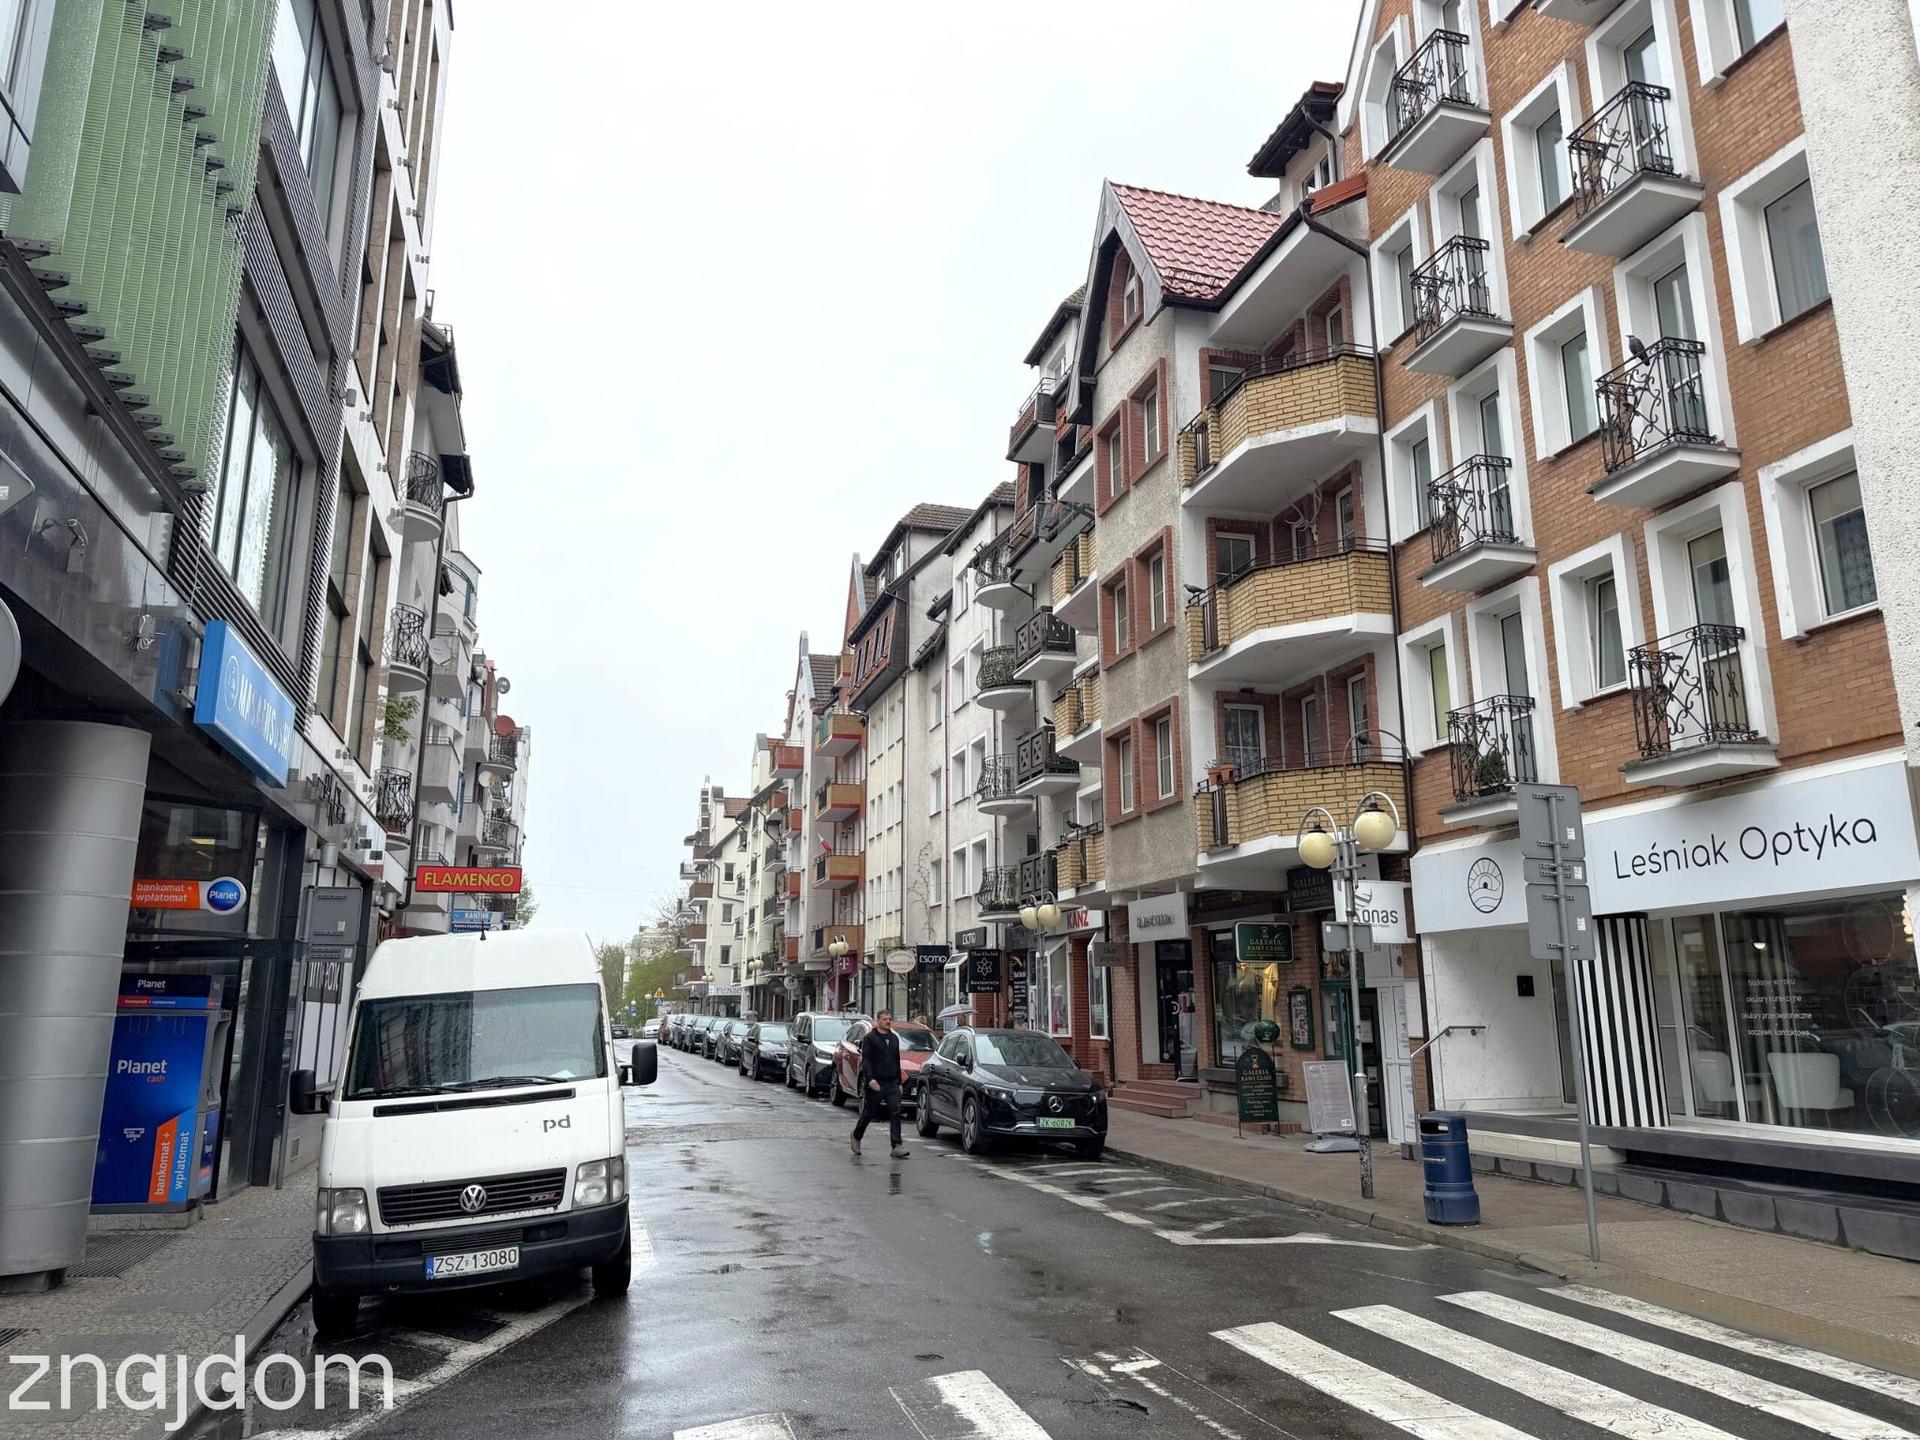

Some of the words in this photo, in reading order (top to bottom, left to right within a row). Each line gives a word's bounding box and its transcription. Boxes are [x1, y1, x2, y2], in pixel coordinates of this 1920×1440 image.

[1614, 833, 1728, 879] Leśniak
[1740, 813, 1876, 865] Optyka
[424, 872, 514, 886] FLAMENCO
[137, 883, 185, 892] bankomat
[136, 893, 188, 902] wpłatomat
[209, 890, 238, 900] Planet
[138, 979, 166, 989] Planet
[117, 1060, 168, 1074] Planet
[543, 1114, 571, 1133] pd
[175, 1130, 190, 1191] wpłatomat
[155, 1141, 171, 1195] bankomat
[435, 1256, 465, 1273] ZSZ
[473, 1249, 517, 1269] 13080
